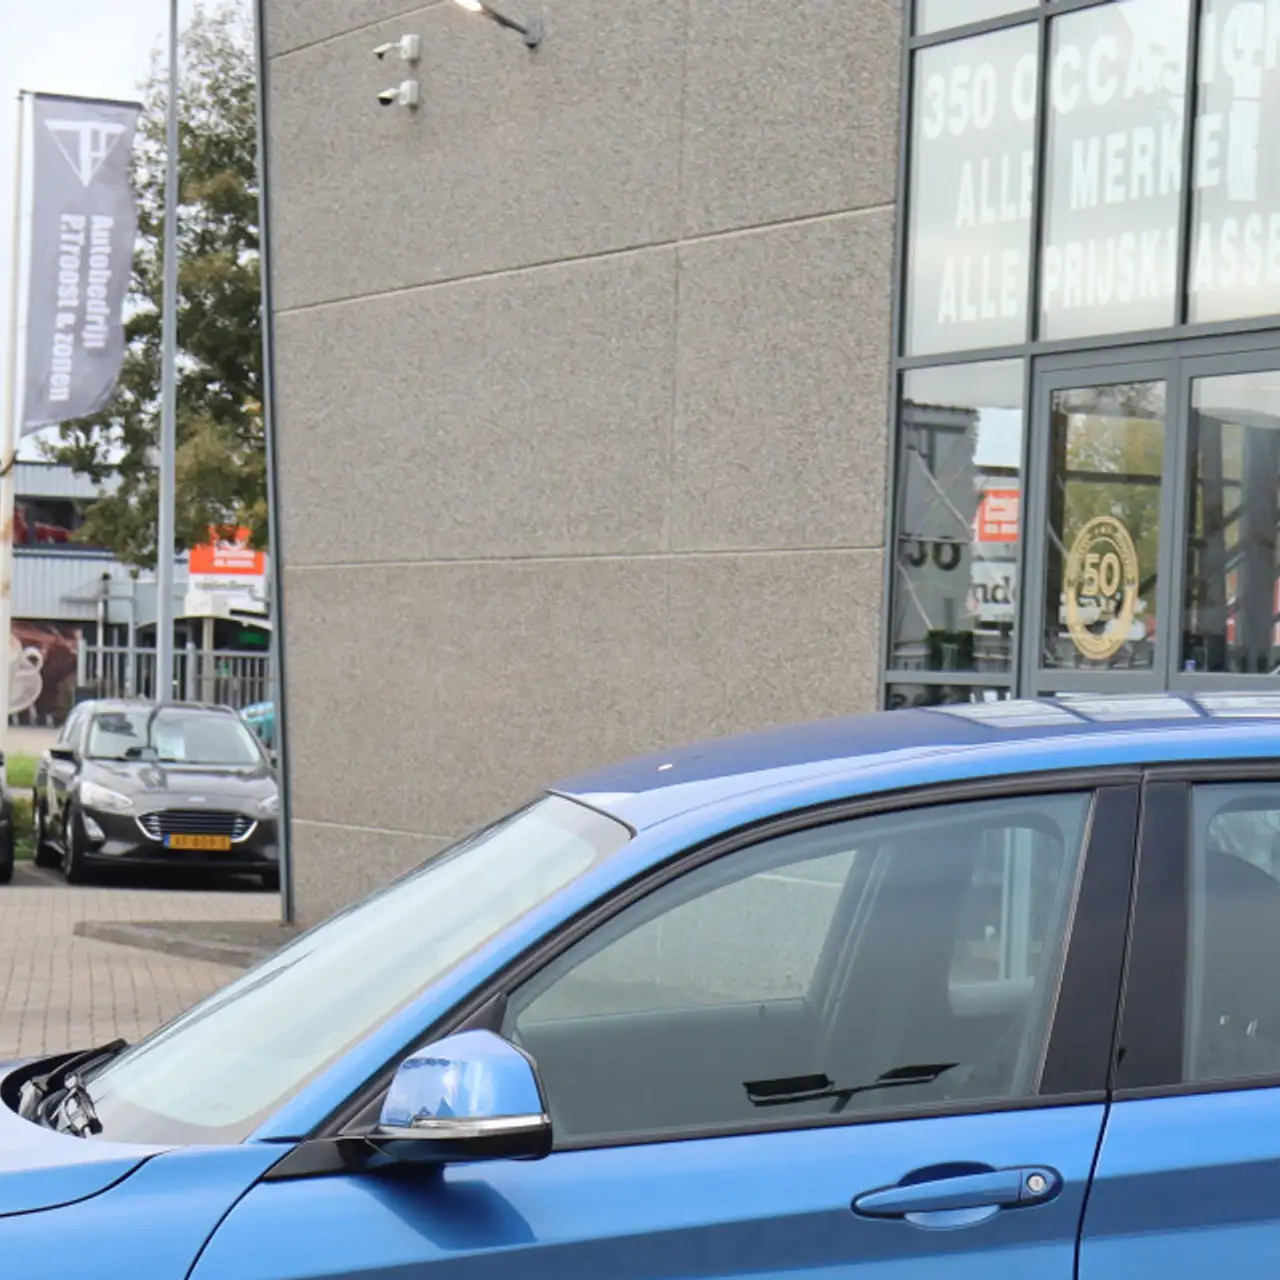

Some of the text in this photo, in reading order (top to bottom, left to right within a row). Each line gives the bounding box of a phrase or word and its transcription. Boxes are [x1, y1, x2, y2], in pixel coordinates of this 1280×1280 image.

[922, 62, 997, 139] 350
[955, 149, 1033, 229] ALLE
[937, 250, 1019, 324] ALLE
[49, 332, 74, 402] zonen
[1081, 552, 1120, 597] 50
